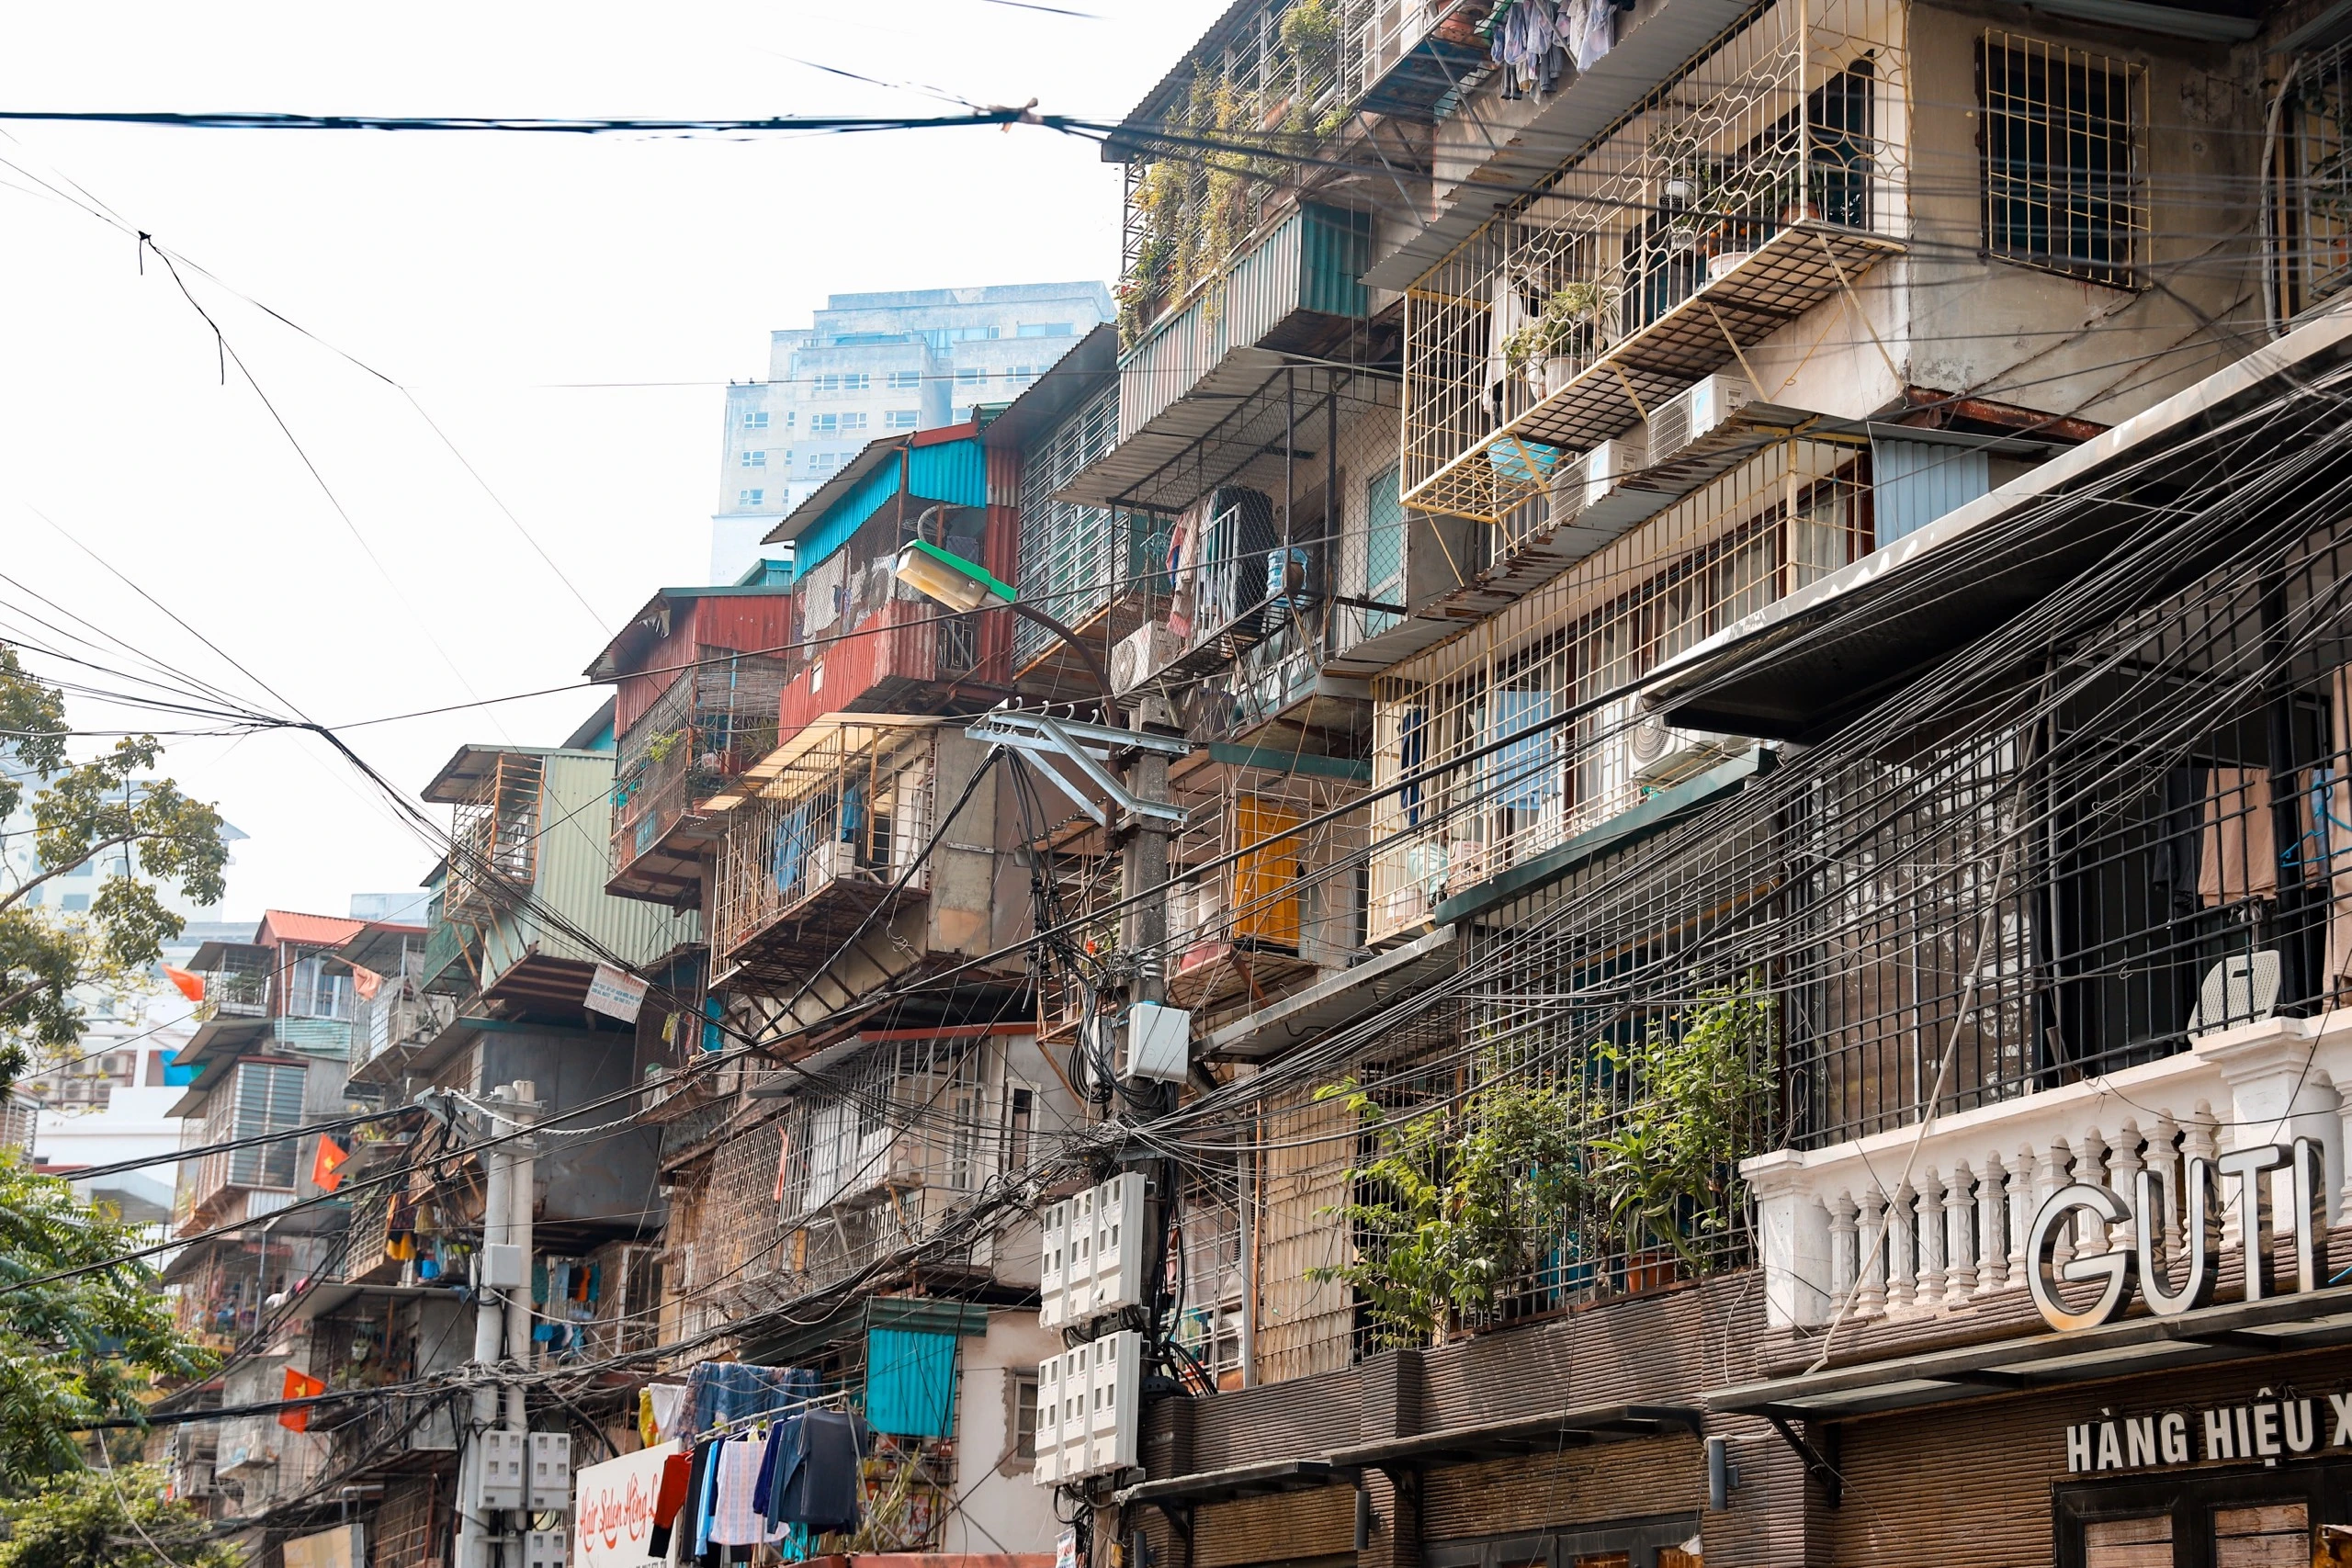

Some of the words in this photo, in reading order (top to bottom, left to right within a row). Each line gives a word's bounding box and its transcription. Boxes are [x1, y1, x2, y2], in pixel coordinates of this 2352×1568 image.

[2027, 1136, 2327, 1332] GUTI
[2067, 1407, 2188, 1472] HÀNG
[2204, 1387, 2313, 1467] HIỆU
[579, 1486, 598, 1552] Hair
[599, 1488, 622, 1549] Salon
